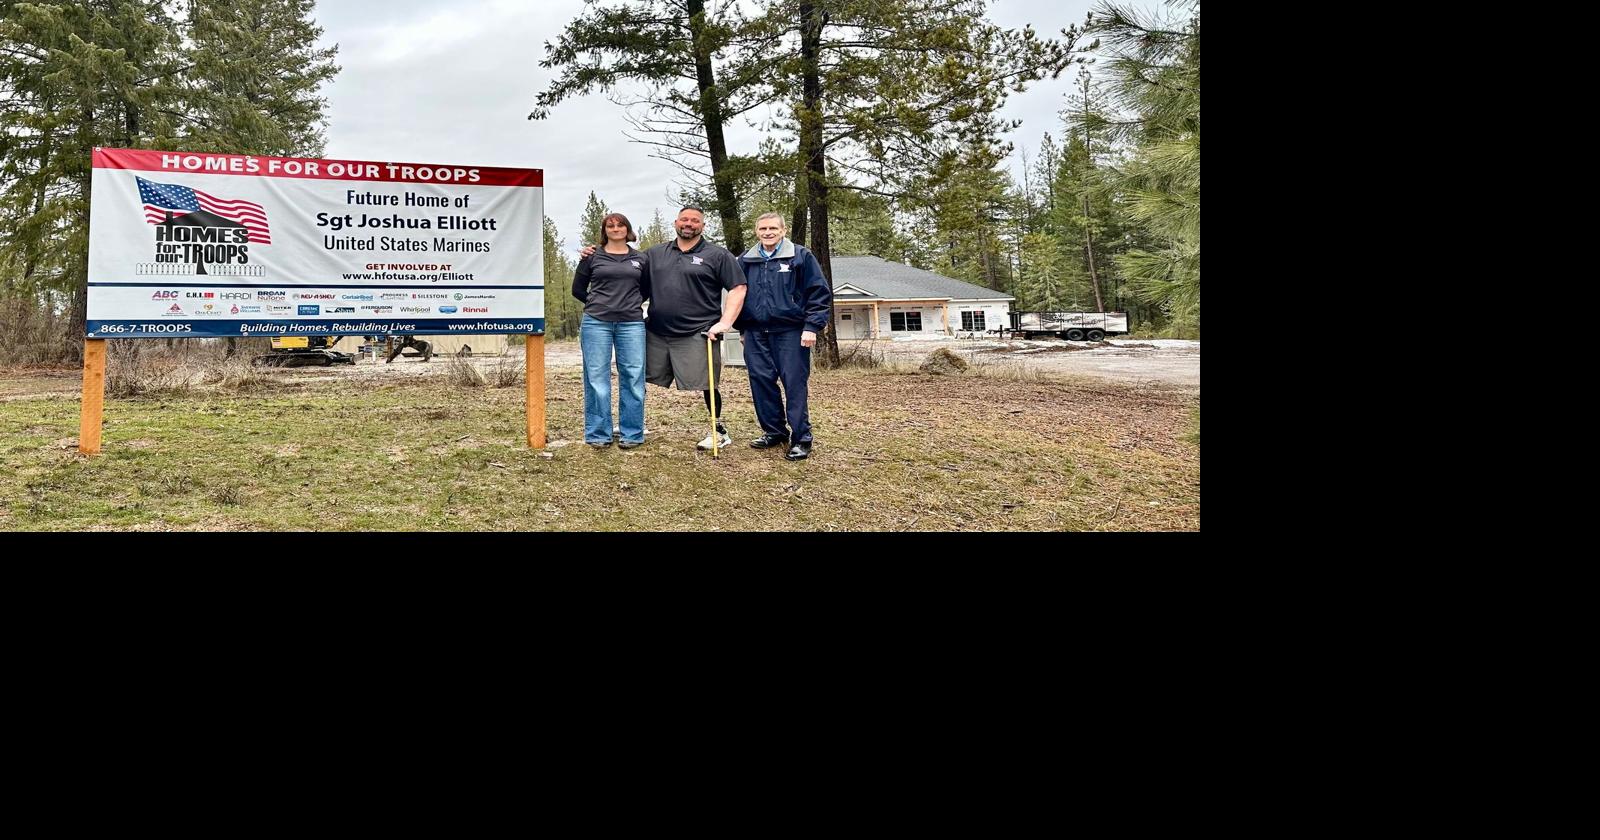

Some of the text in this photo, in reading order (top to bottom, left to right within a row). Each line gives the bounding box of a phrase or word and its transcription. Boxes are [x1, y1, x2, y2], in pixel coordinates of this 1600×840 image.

[162, 154, 481, 182] HOMES FOR OUR TROOPS
[347, 190, 470, 208] Future Home of
[316, 212, 497, 231] Sgt Joshua Elliott
[156, 226, 249, 244] HOMES
[155, 242, 181, 253] for
[324, 235, 490, 253] United States Marines
[155, 253, 183, 263] our
[182, 243, 248, 275] TROOPS
[365, 263, 385, 271] GET
[387, 263, 438, 271] INVOLVED
[342, 272, 474, 282] www.hfotusa.org/Elliott
[152, 290, 179, 299] ABC
[220, 292, 252, 300] HARDI
[400, 306, 431, 314] Whirlpool
[100, 324, 192, 333] 866-7-TROOPS
[240, 323, 415, 333] Building Homes, Rebuilding Lives
[448, 322, 534, 332] www.hfotusa.org
